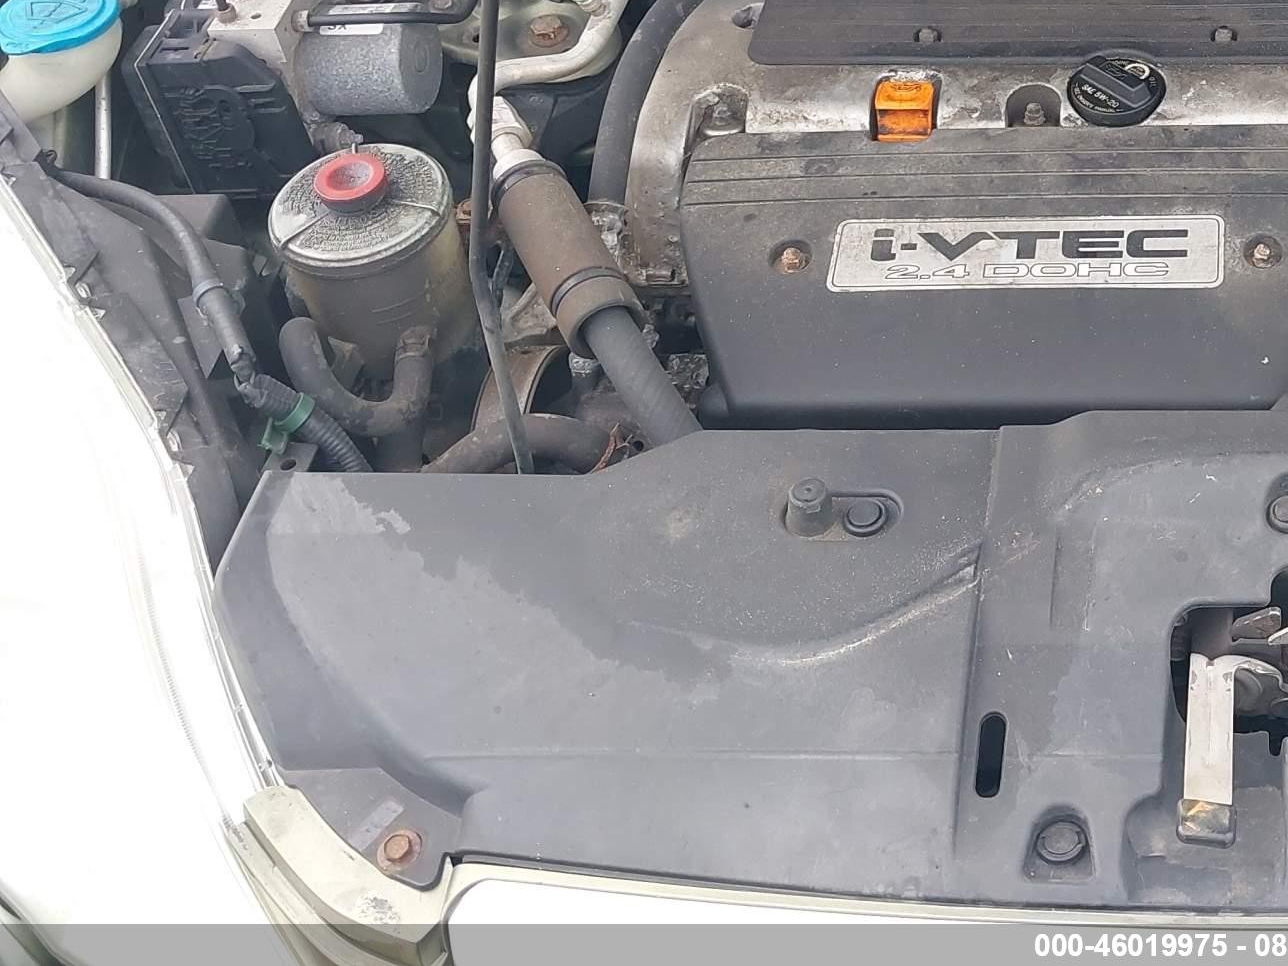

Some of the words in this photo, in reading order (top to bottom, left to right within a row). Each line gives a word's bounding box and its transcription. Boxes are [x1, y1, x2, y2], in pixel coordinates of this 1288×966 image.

[870, 228, 1188, 262] i-VTEC
[885, 263, 970, 281] 2.4
[982, 262, 1170, 279] DOHC
